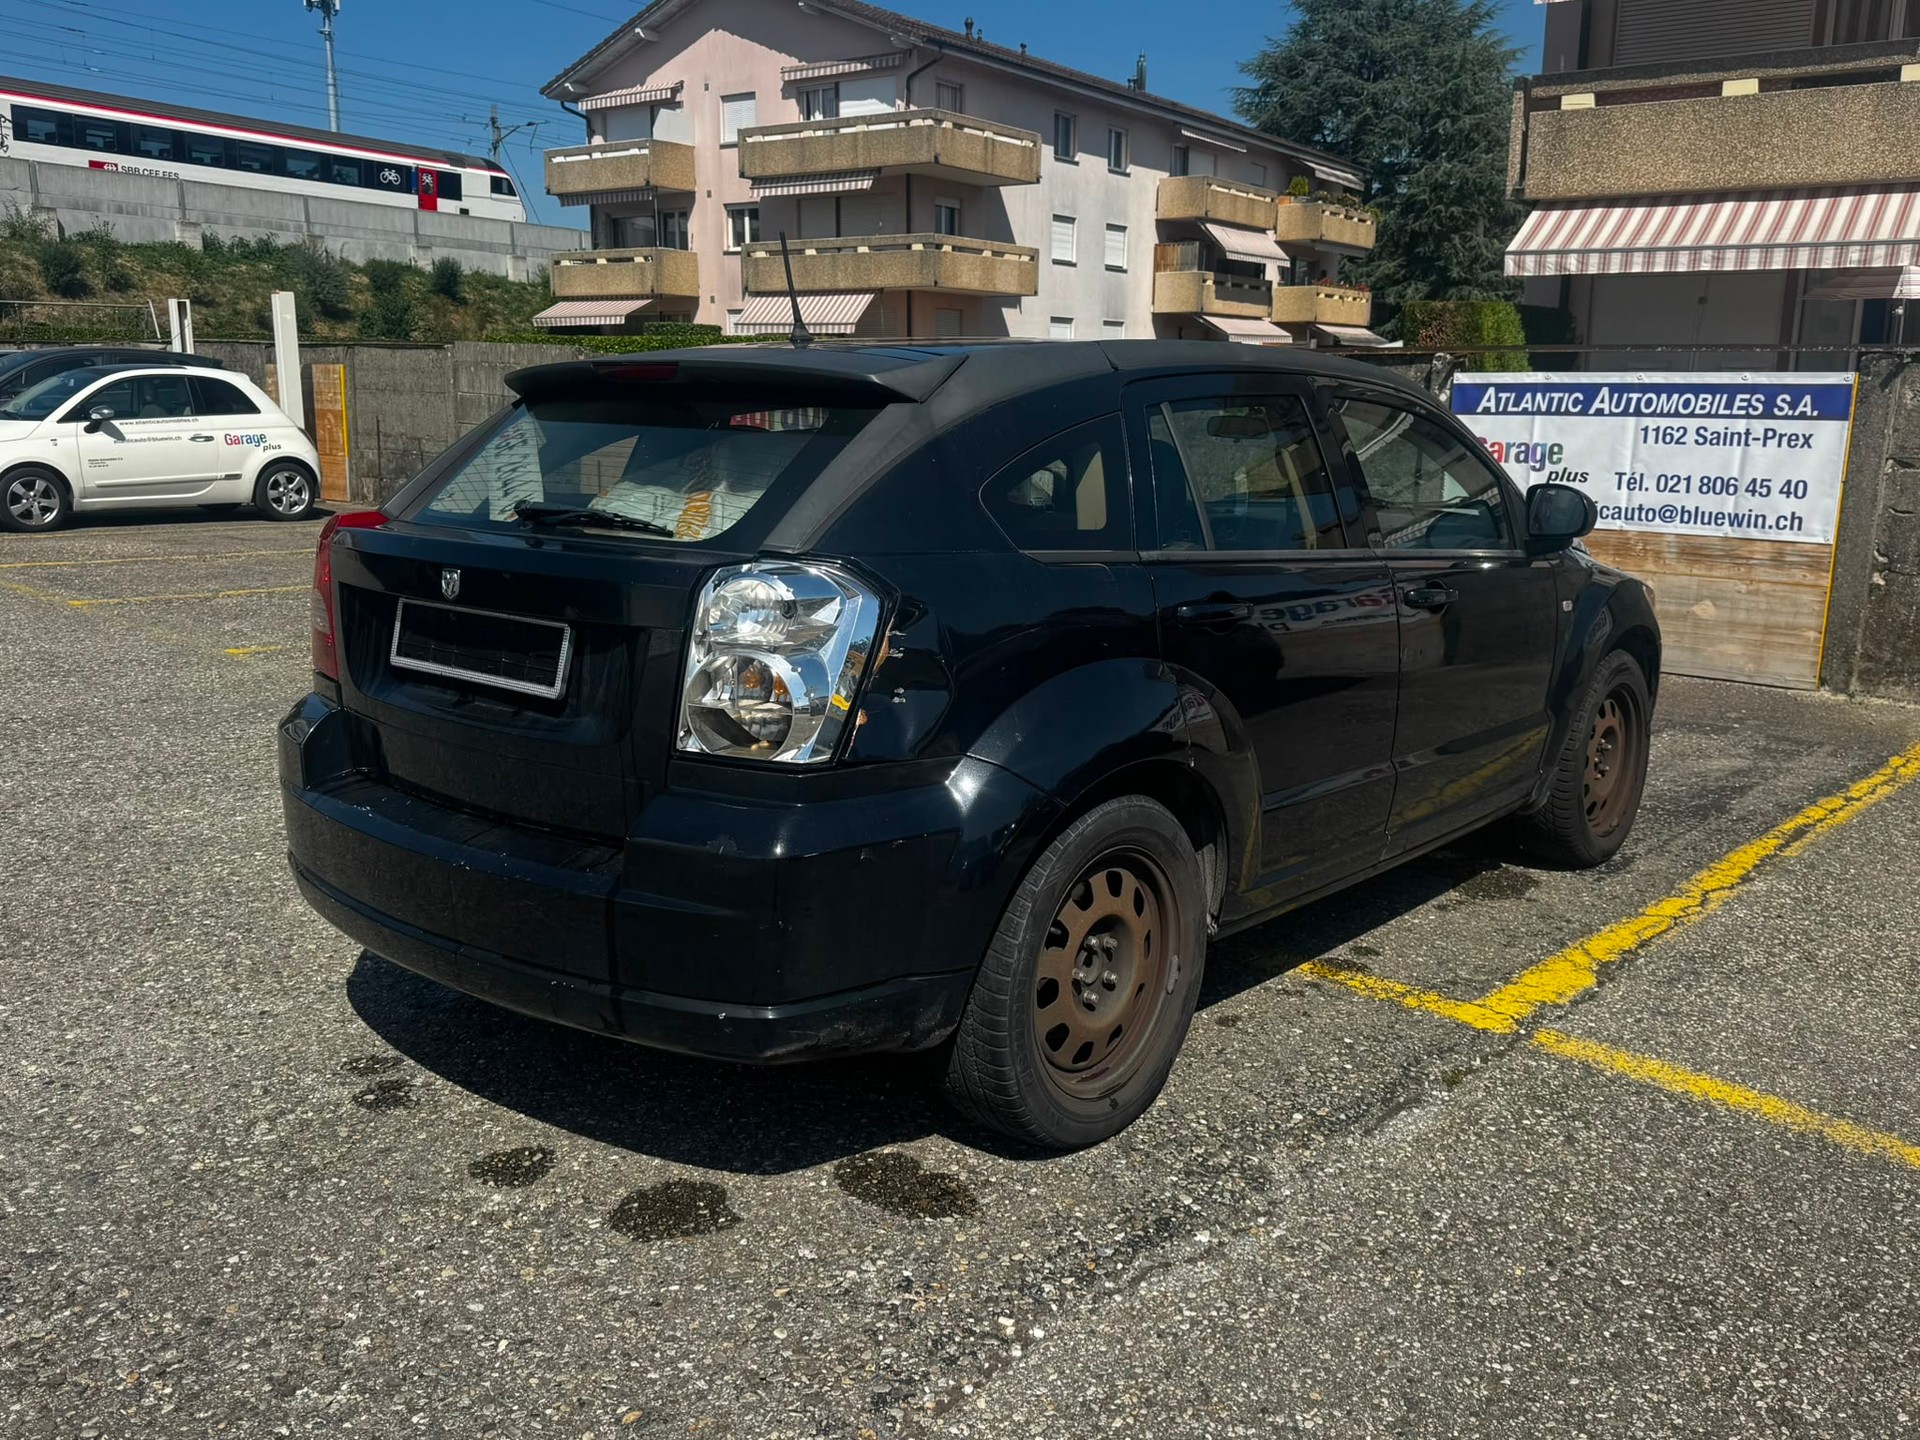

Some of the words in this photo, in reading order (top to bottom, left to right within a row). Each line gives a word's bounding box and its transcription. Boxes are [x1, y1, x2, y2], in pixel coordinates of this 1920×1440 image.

[121, 166, 140, 174] SBB
[1477, 386, 1583, 414] ATLANTIC
[1588, 386, 1766, 417] AUTOMOBILES
[1773, 394, 1820, 417] S.A.
[224, 433, 268, 447] Garage
[1640, 424, 1689, 445] 1162
[1693, 426, 1814, 449] Saint-Prex
[262, 443, 282, 453] plus
[1546, 467, 1590, 483] plus
[1614, 471, 1649, 492] Tél.
[1655, 473, 1691, 494] 021
[1697, 476, 1738, 496] 806
[1744, 477, 1772, 498] 45
[1778, 478, 1808, 499] 40
[1595, 500, 1804, 532] cauto@bluewin.ch
